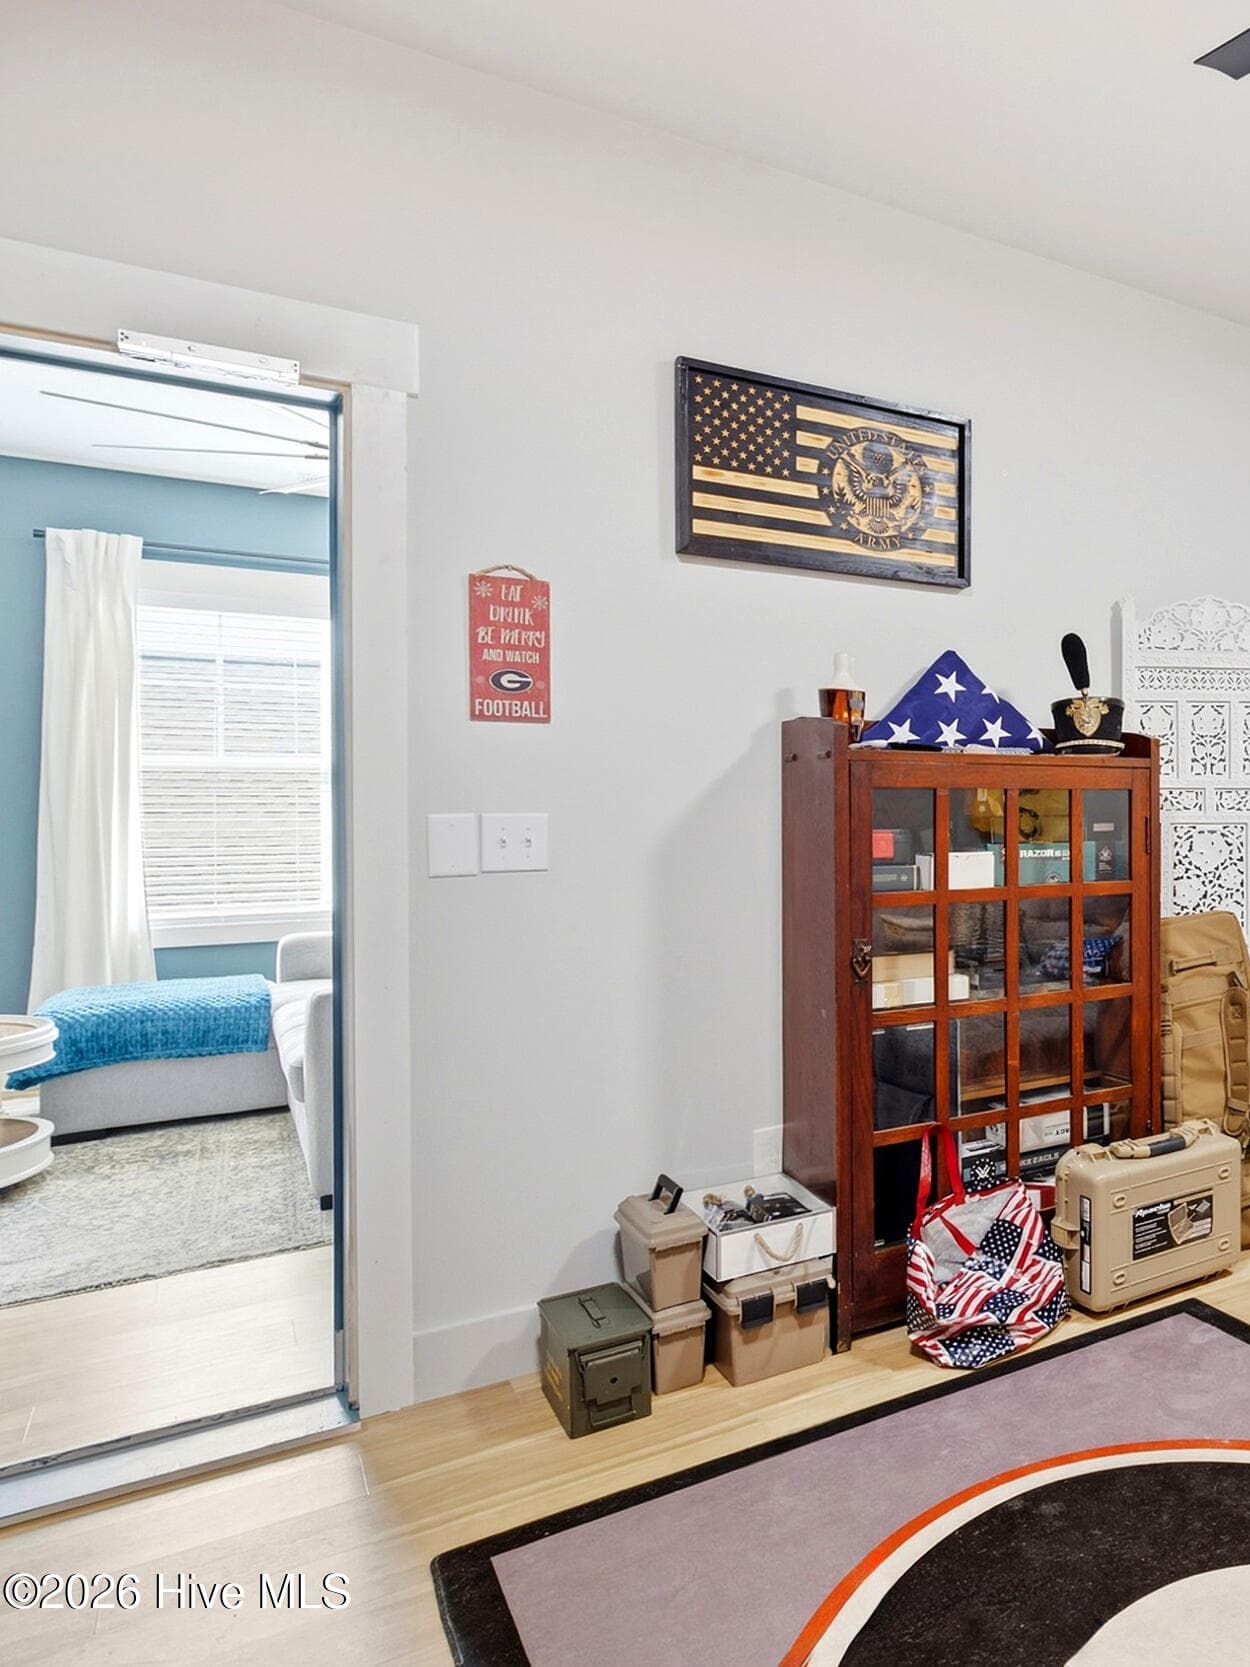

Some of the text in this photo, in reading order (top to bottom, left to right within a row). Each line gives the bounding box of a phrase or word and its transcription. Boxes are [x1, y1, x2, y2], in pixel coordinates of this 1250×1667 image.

[826, 429, 927, 475] UNITED STATES
[854, 532, 901, 549] ARMY
[501, 584, 523, 602] EAT
[489, 604, 534, 625] DRINK
[476, 626, 545, 648] BE MERRY
[482, 648, 540, 664] AND WATCH
[475, 698, 548, 718] FOOTBALL
